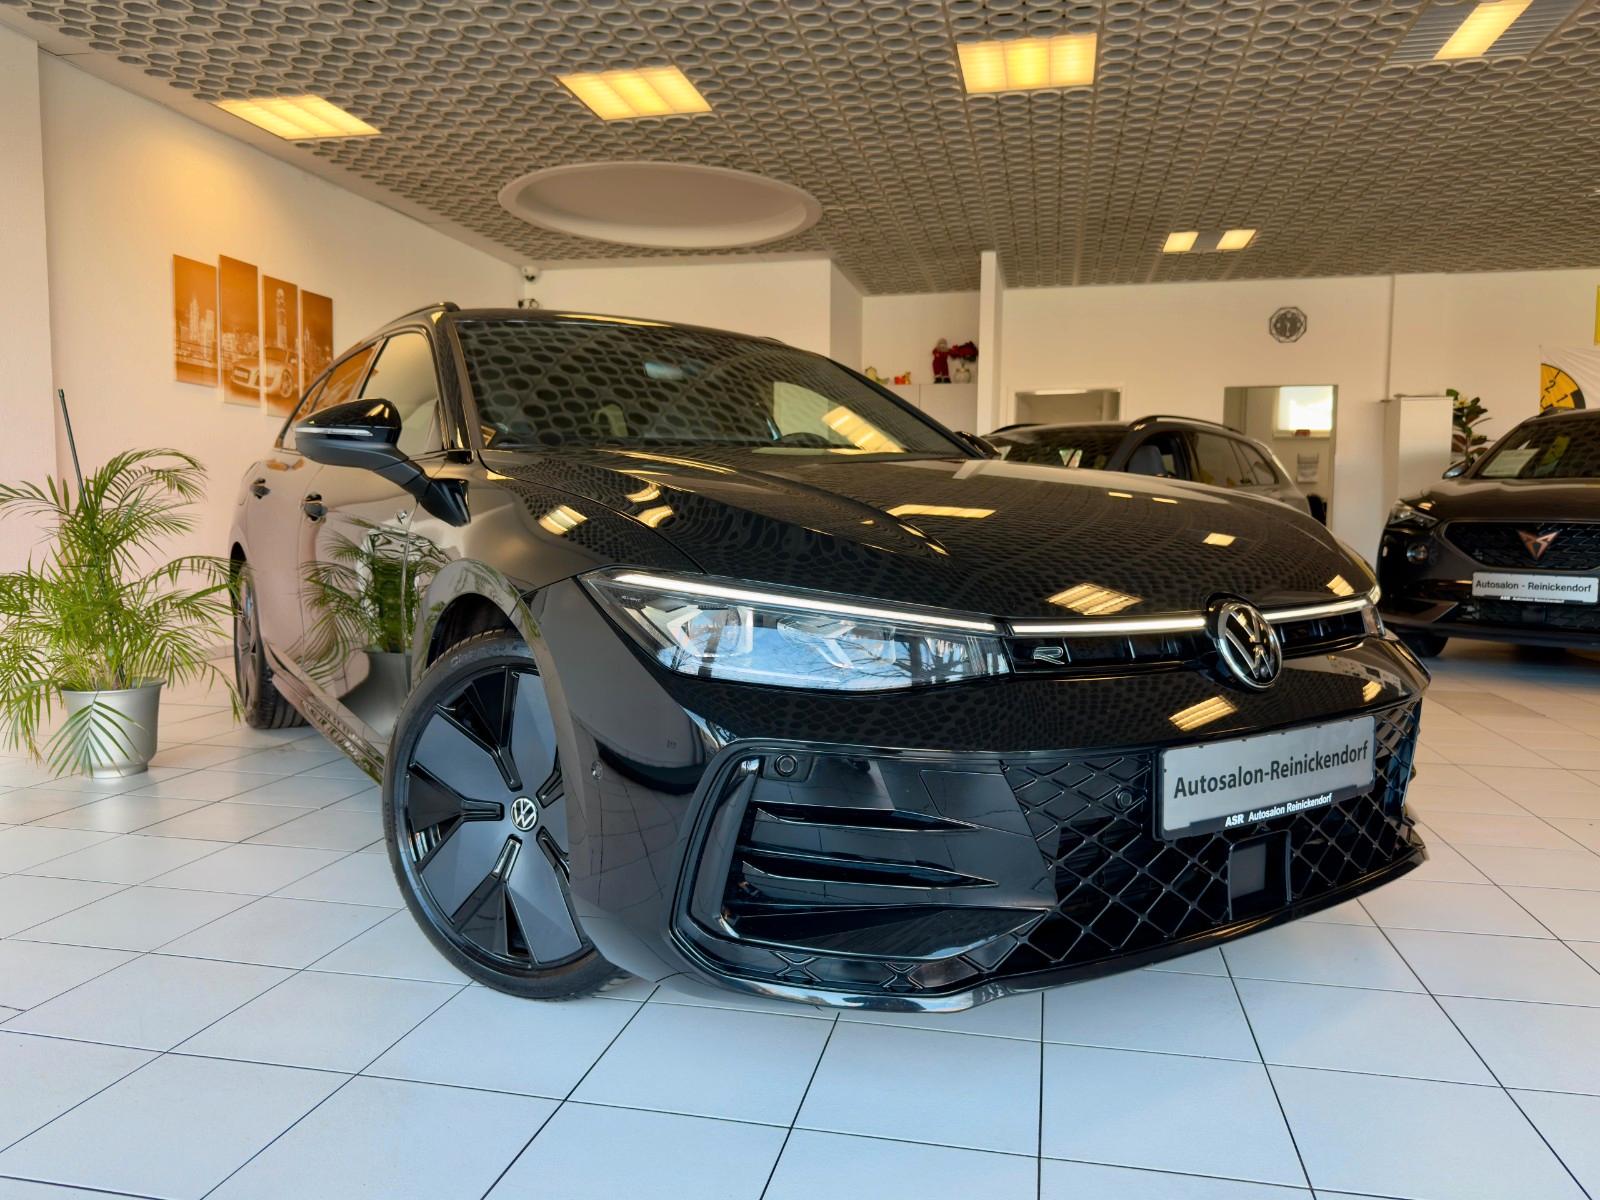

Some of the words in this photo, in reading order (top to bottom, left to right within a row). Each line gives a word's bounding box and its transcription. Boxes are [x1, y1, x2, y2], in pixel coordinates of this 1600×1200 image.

[1475, 579, 1519, 590] Autosalon
[1527, 581, 1592, 593] Reinickendorf
[1173, 740, 1369, 799] Autosalon-Reinickendorf
[511, 797, 537, 831] VW
[1224, 813, 1245, 828] ASR
[1247, 806, 1286, 823] Autosalon
[1286, 792, 1333, 813] Reinickendorf
